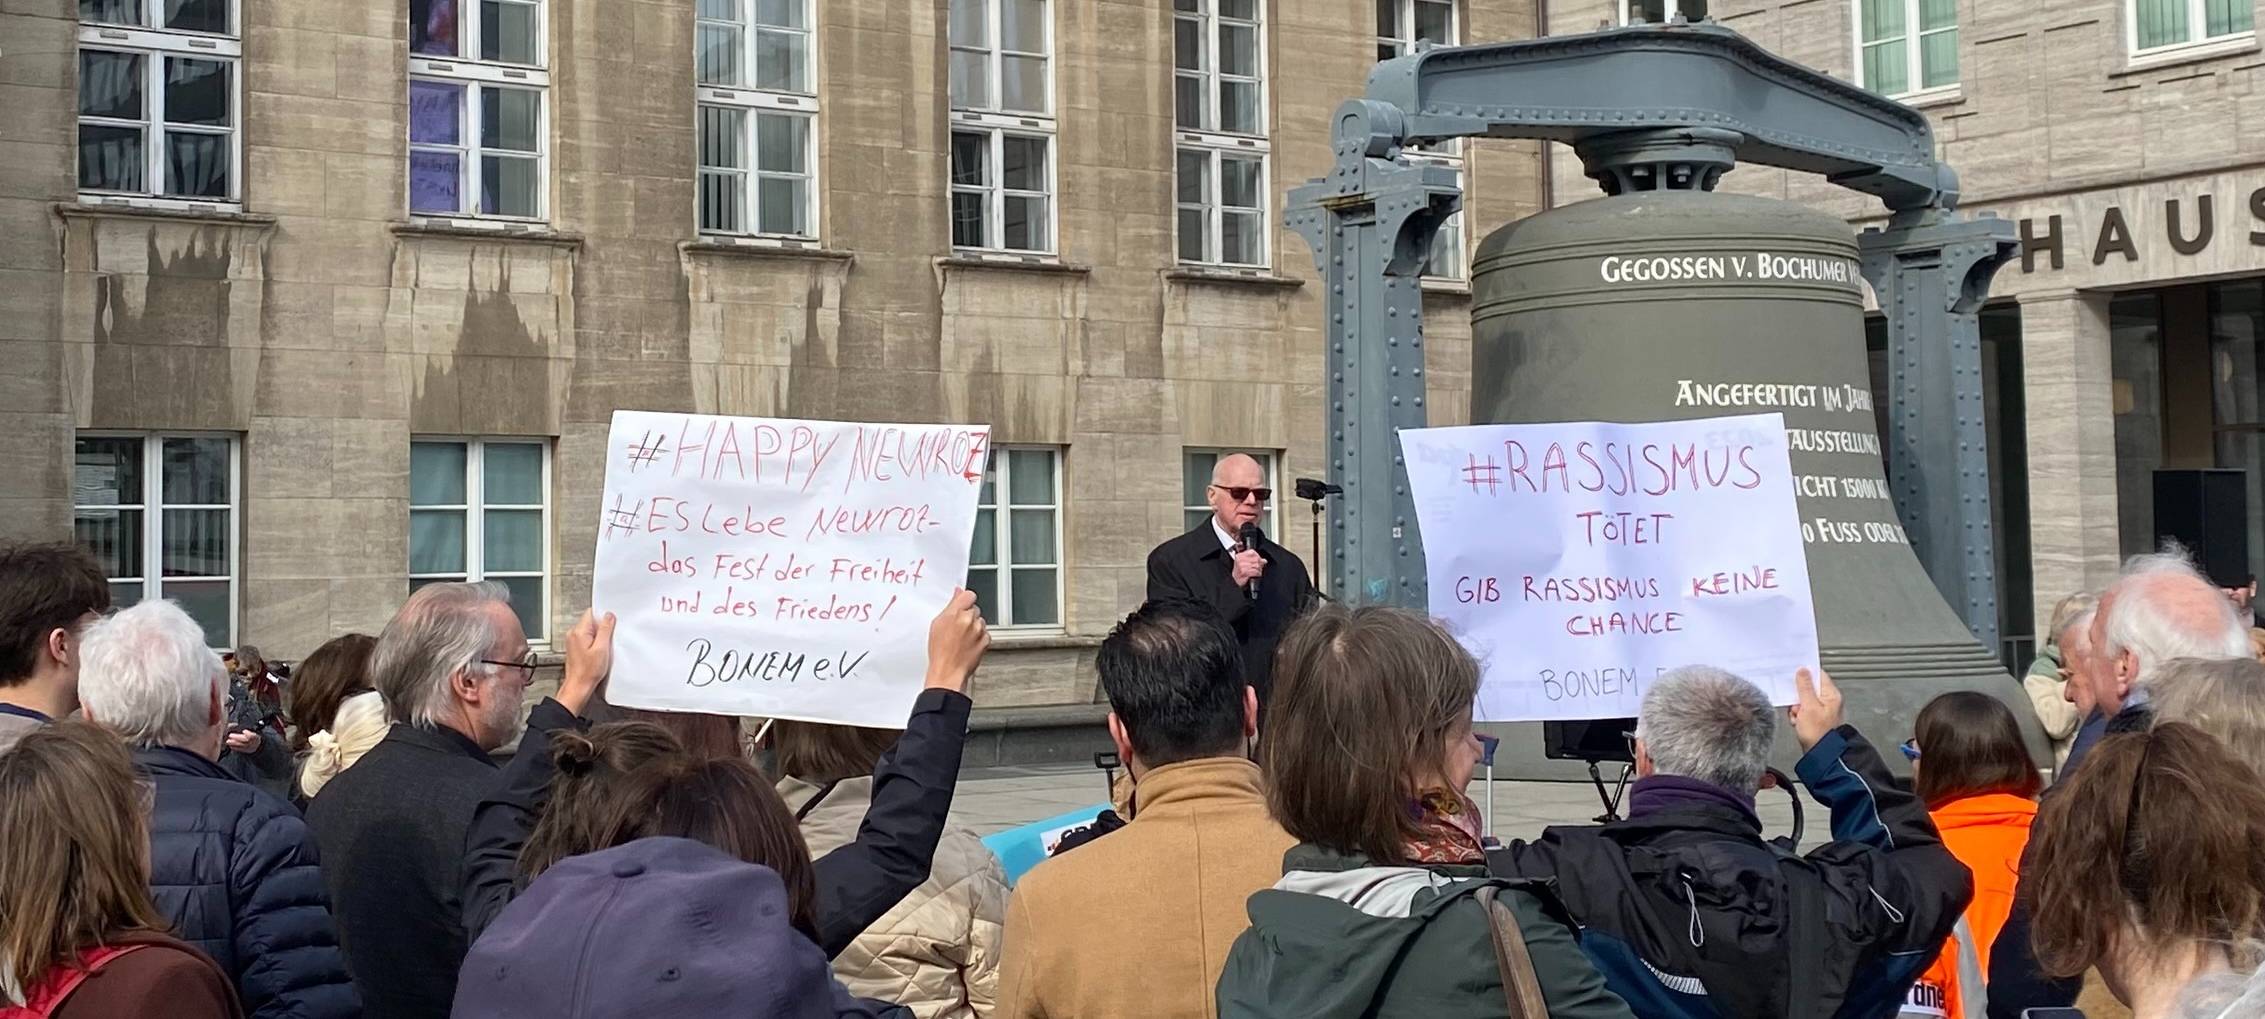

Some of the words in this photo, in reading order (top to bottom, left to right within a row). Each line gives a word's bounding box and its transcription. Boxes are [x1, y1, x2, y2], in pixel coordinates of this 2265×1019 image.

[844, 425, 989, 495] NEWROZ
[1462, 440, 1761, 497] #RASSISMUS
[1841, 477, 1877, 499] 15000
[647, 540, 697, 577] das
[713, 552, 769, 581] Fest
[774, 555, 814, 582] der
[830, 557, 926, 587] Freiheit
[661, 590, 701, 615] und
[713, 586, 757, 617] des
[1455, 576, 1500, 604] GIB
[1523, 576, 1660, 603] RASSISMUS
[1691, 566, 1779, 599] KEINE
[1566, 612, 1684, 636] CHANCE
[686, 637, 805, 688] BONEM
[1539, 667, 1639, 702] BONEM
